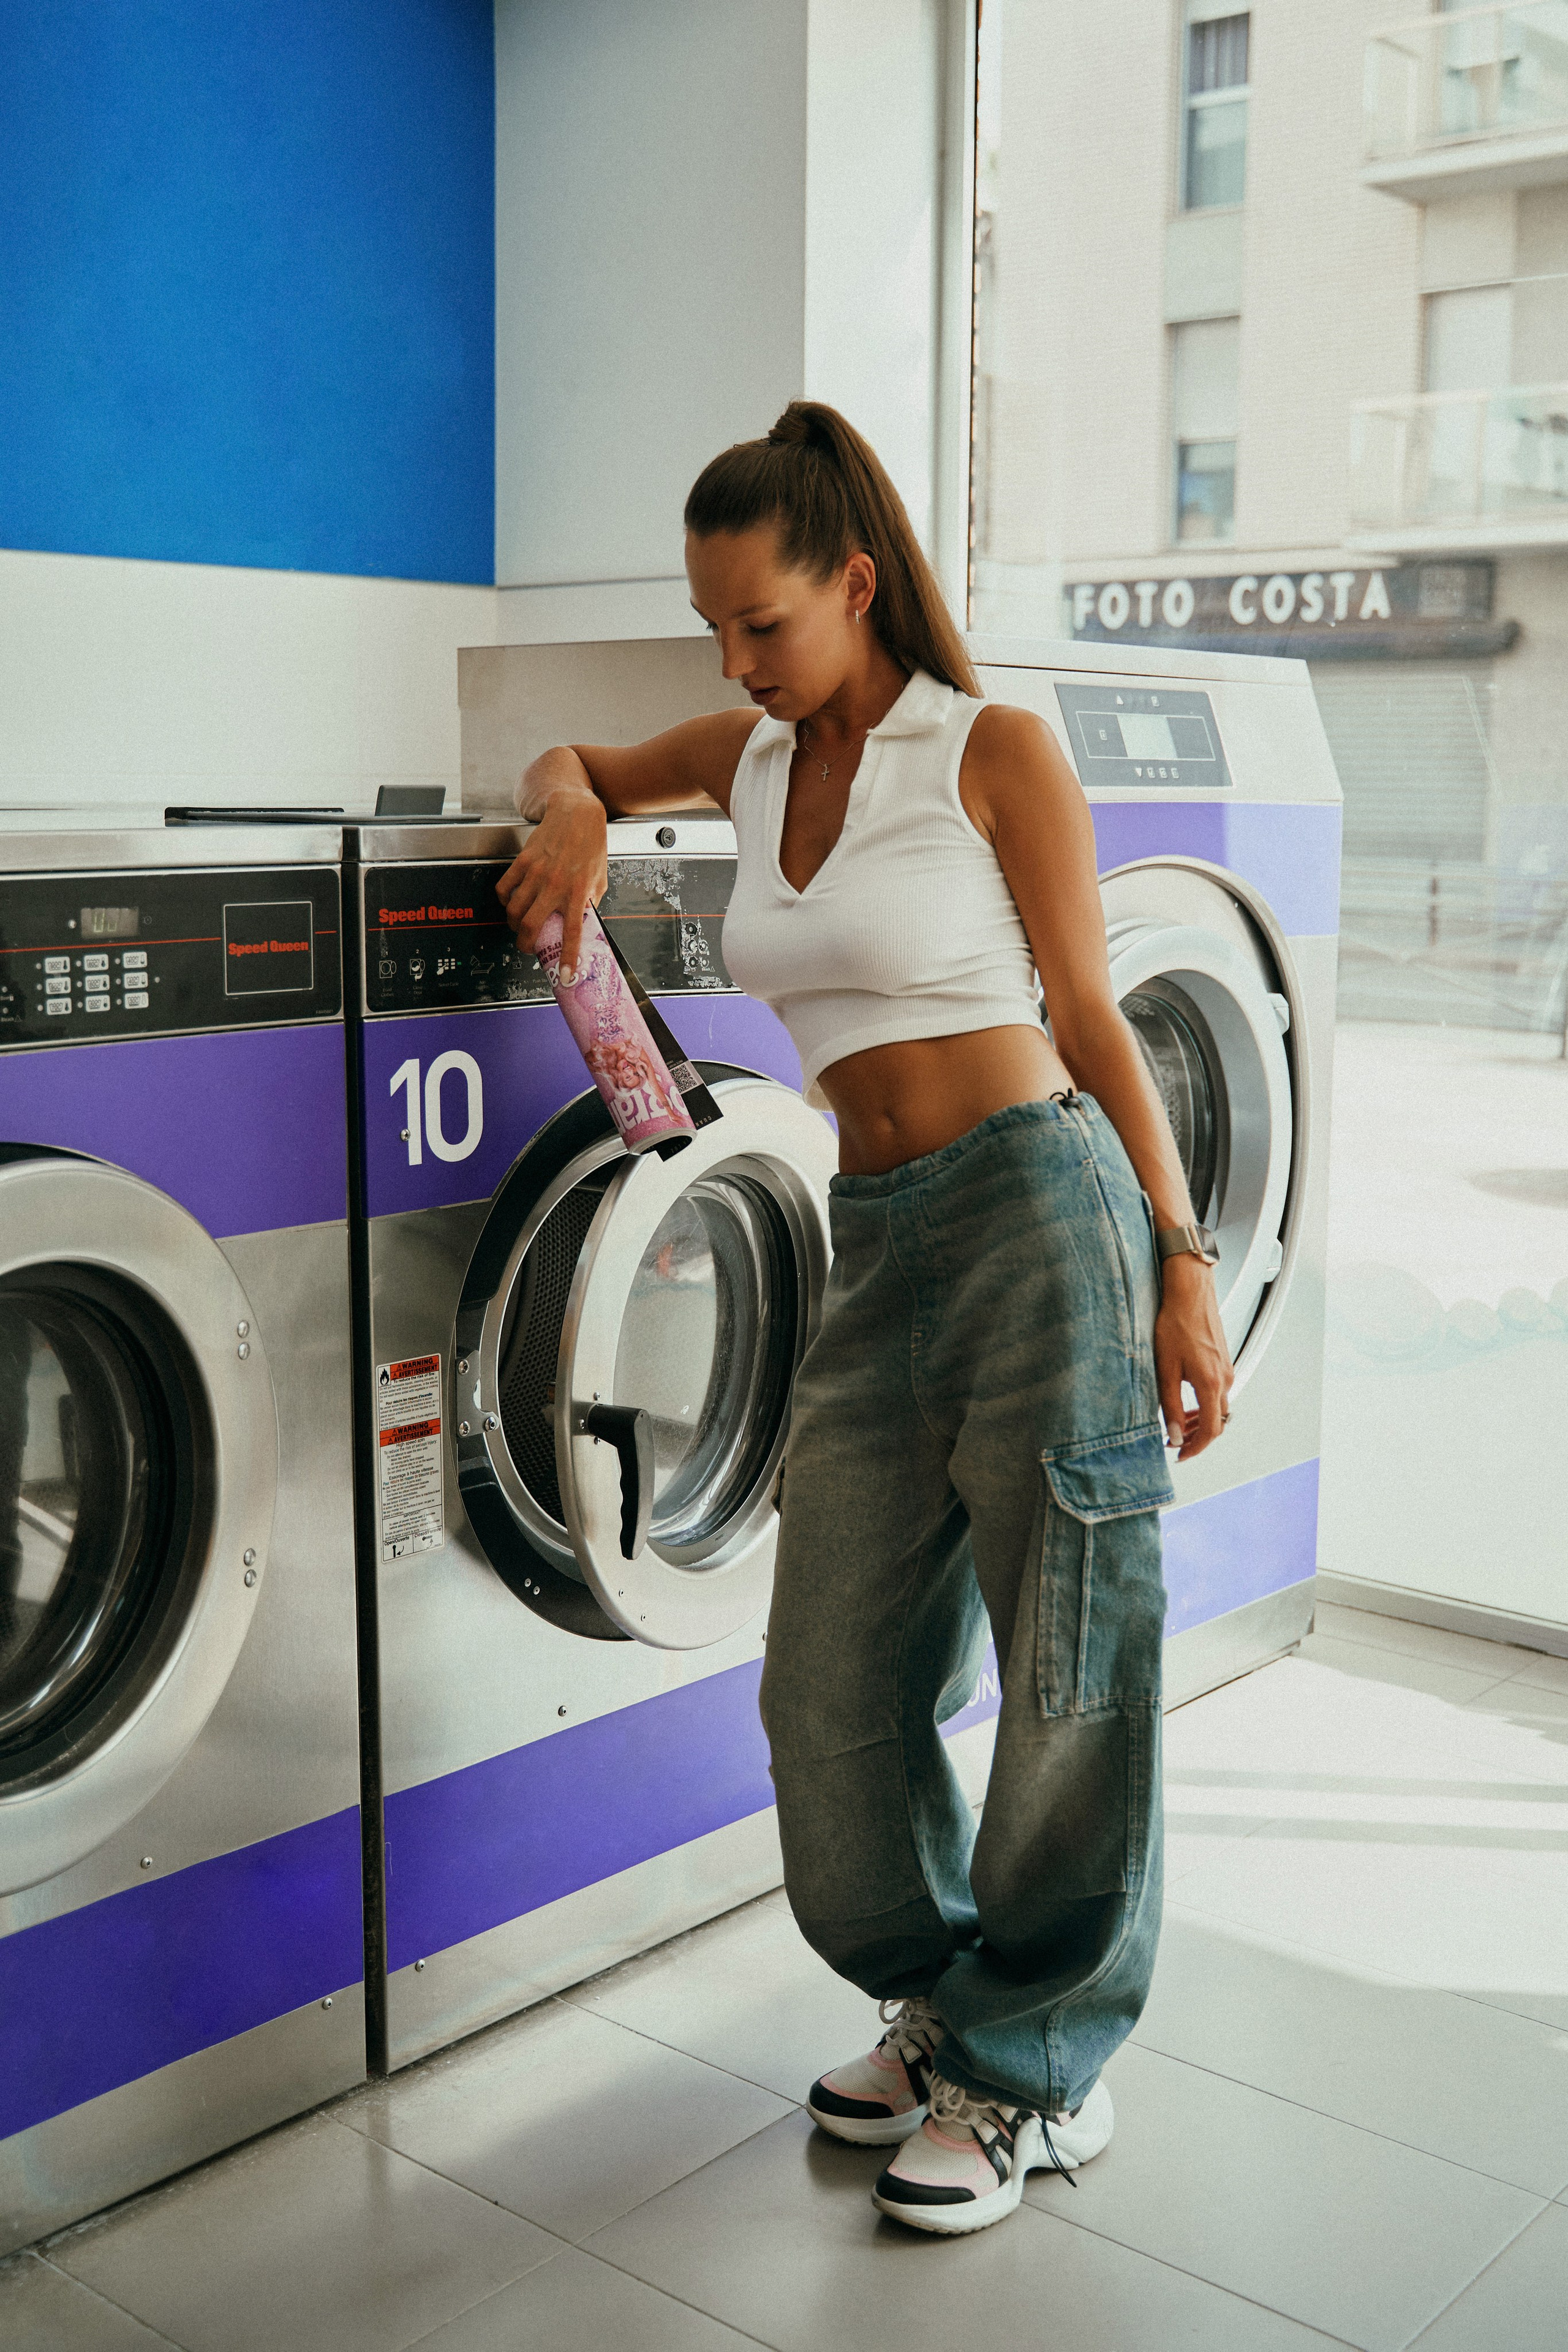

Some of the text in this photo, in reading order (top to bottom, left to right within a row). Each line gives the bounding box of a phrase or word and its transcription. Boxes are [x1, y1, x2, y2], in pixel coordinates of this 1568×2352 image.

[1072, 570, 1392, 630] FOTO COSTA
[379, 905, 473, 925] Speed Queen
[228, 940, 309, 957] Speed Queen
[547, 942, 562, 952] IT'S
[390, 1049, 484, 1166] 10
[695, 1115, 712, 1128] CUAN
[402, 1357, 433, 1370] WARNING
[398, 1364, 437, 1377] AVERTISSEMENT
[397, 1422, 428, 1434] WARNING
[394, 1428, 432, 1442] AVERTISSEMENT
[388, 1472, 405, 1480] Essorage
[384, 1535, 409, 1547] Open/Ouverte
